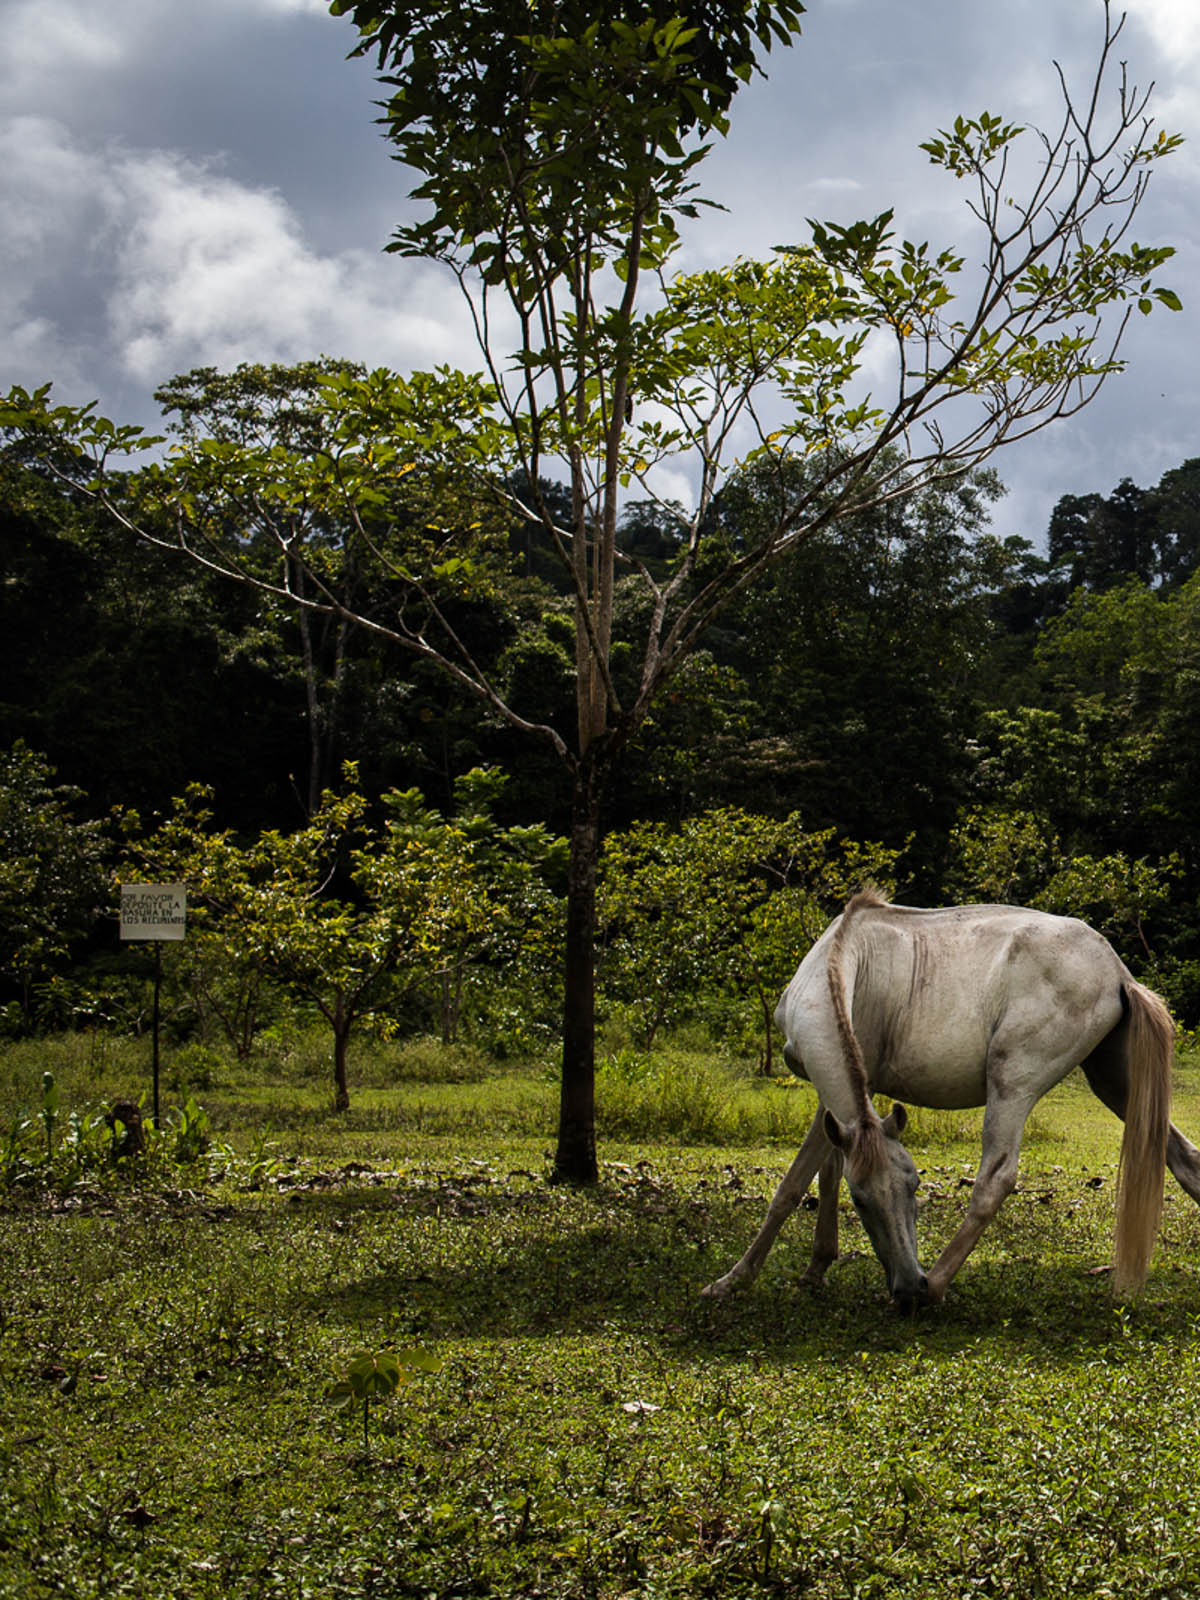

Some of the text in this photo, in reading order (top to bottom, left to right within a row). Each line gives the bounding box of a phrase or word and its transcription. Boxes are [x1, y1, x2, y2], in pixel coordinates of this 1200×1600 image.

[141, 894, 173, 902] FAVOR
[168, 901, 180, 909] LA
[122, 916, 139, 924] LOS
